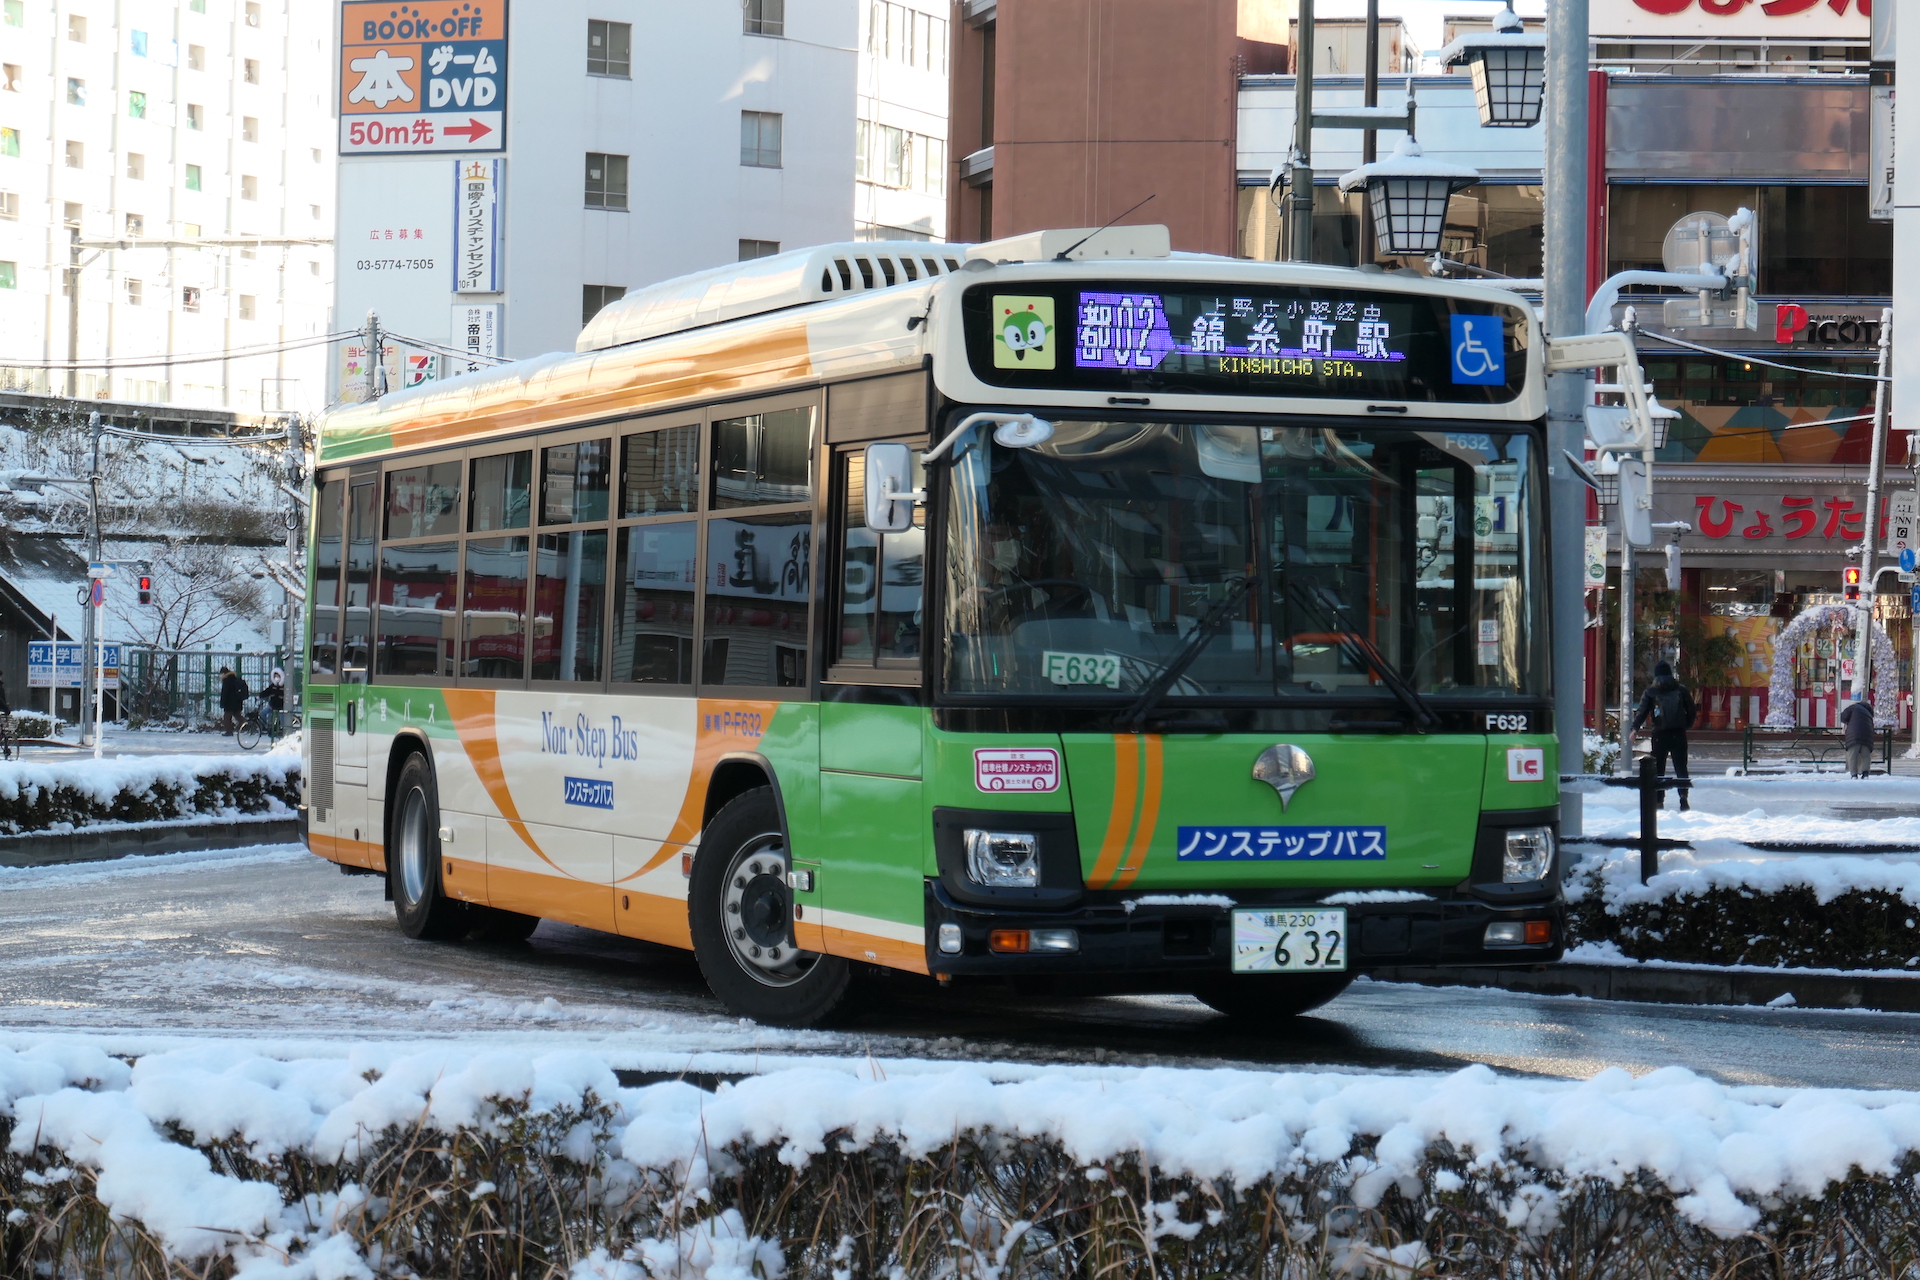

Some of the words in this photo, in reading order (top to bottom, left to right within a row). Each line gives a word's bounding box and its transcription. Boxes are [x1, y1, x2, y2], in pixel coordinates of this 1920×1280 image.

[428, 45, 498, 76] ゲーム
[348, 49, 415, 109] 本
[429, 77, 497, 108] DVD
[349, 119, 434, 145] 50m先
[369, 228, 423, 240] 広告募集
[467, 182, 485, 288] 国際クリスチャンセンター
[356, 259, 434, 270] 03-5774-7505
[459, 280, 471, 289] 10F
[1205, 297, 1382, 322] 上野広小路経由
[1191, 316, 1390, 359] 錦糸町駅
[1323, 360, 1363, 378] STA.
[1445, 434, 1489, 450] F632
[1048, 655, 1116, 685] F632
[1485, 714, 1528, 731] F632
[611, 715, 638, 761] Bus
[982, 763, 1053, 773] 標準仕様ノンステップバス
[565, 780, 614, 806] ノンステップバス
[1179, 831, 1385, 857] ノンステップバス
